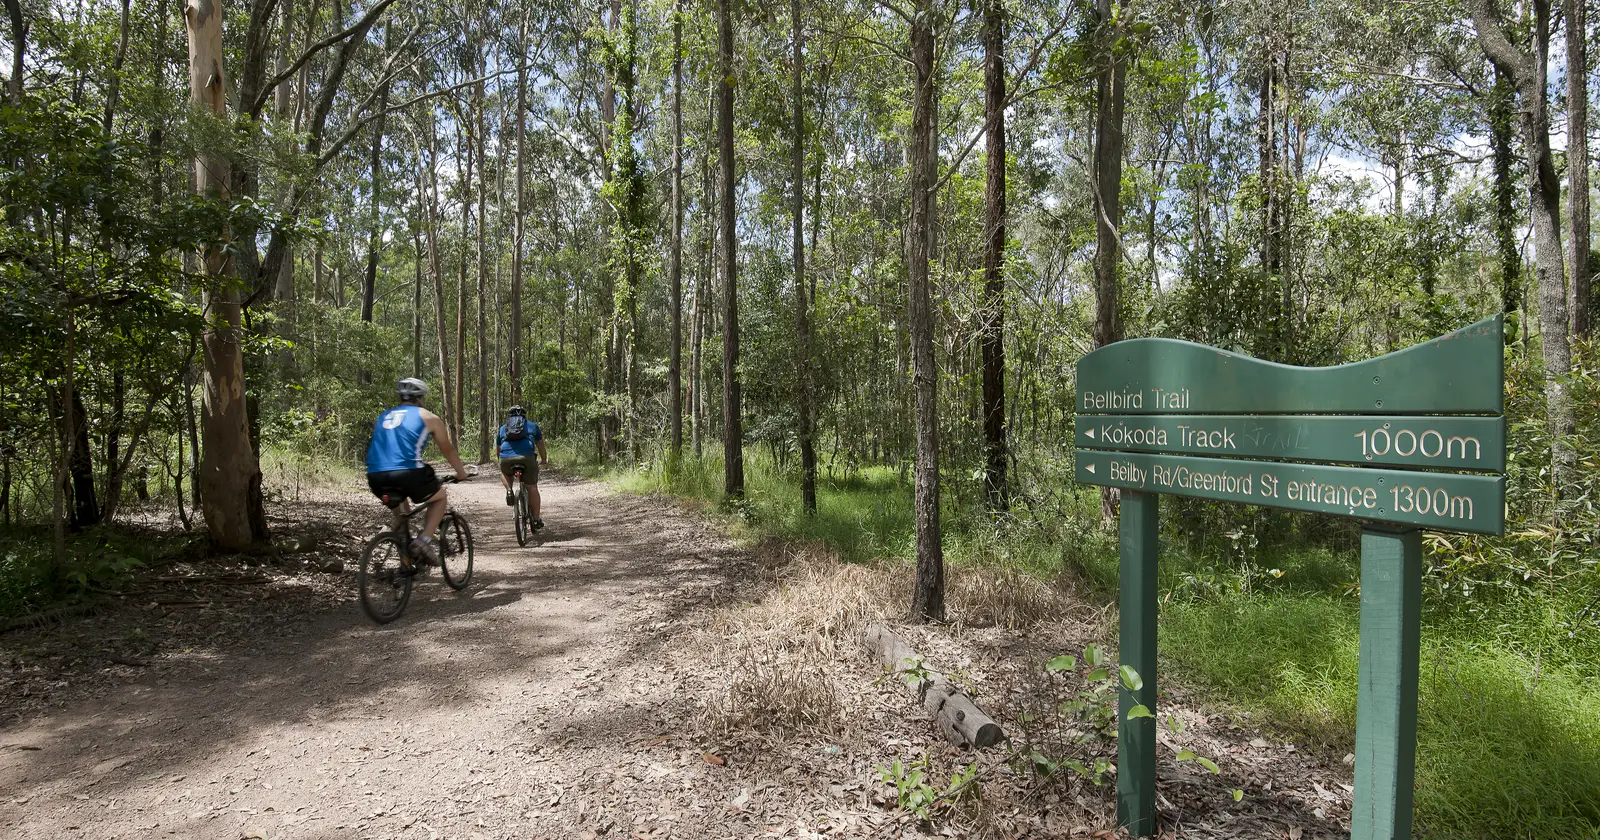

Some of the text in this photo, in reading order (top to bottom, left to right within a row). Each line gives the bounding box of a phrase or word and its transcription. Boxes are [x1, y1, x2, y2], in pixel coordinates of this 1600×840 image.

[1083, 387, 1190, 409] Bellbird Trail
[1101, 423, 1481, 460] Kokoda Track 1000m
[1110, 460, 1473, 520] Beilby Rd/Greenford St entrance 1300m
